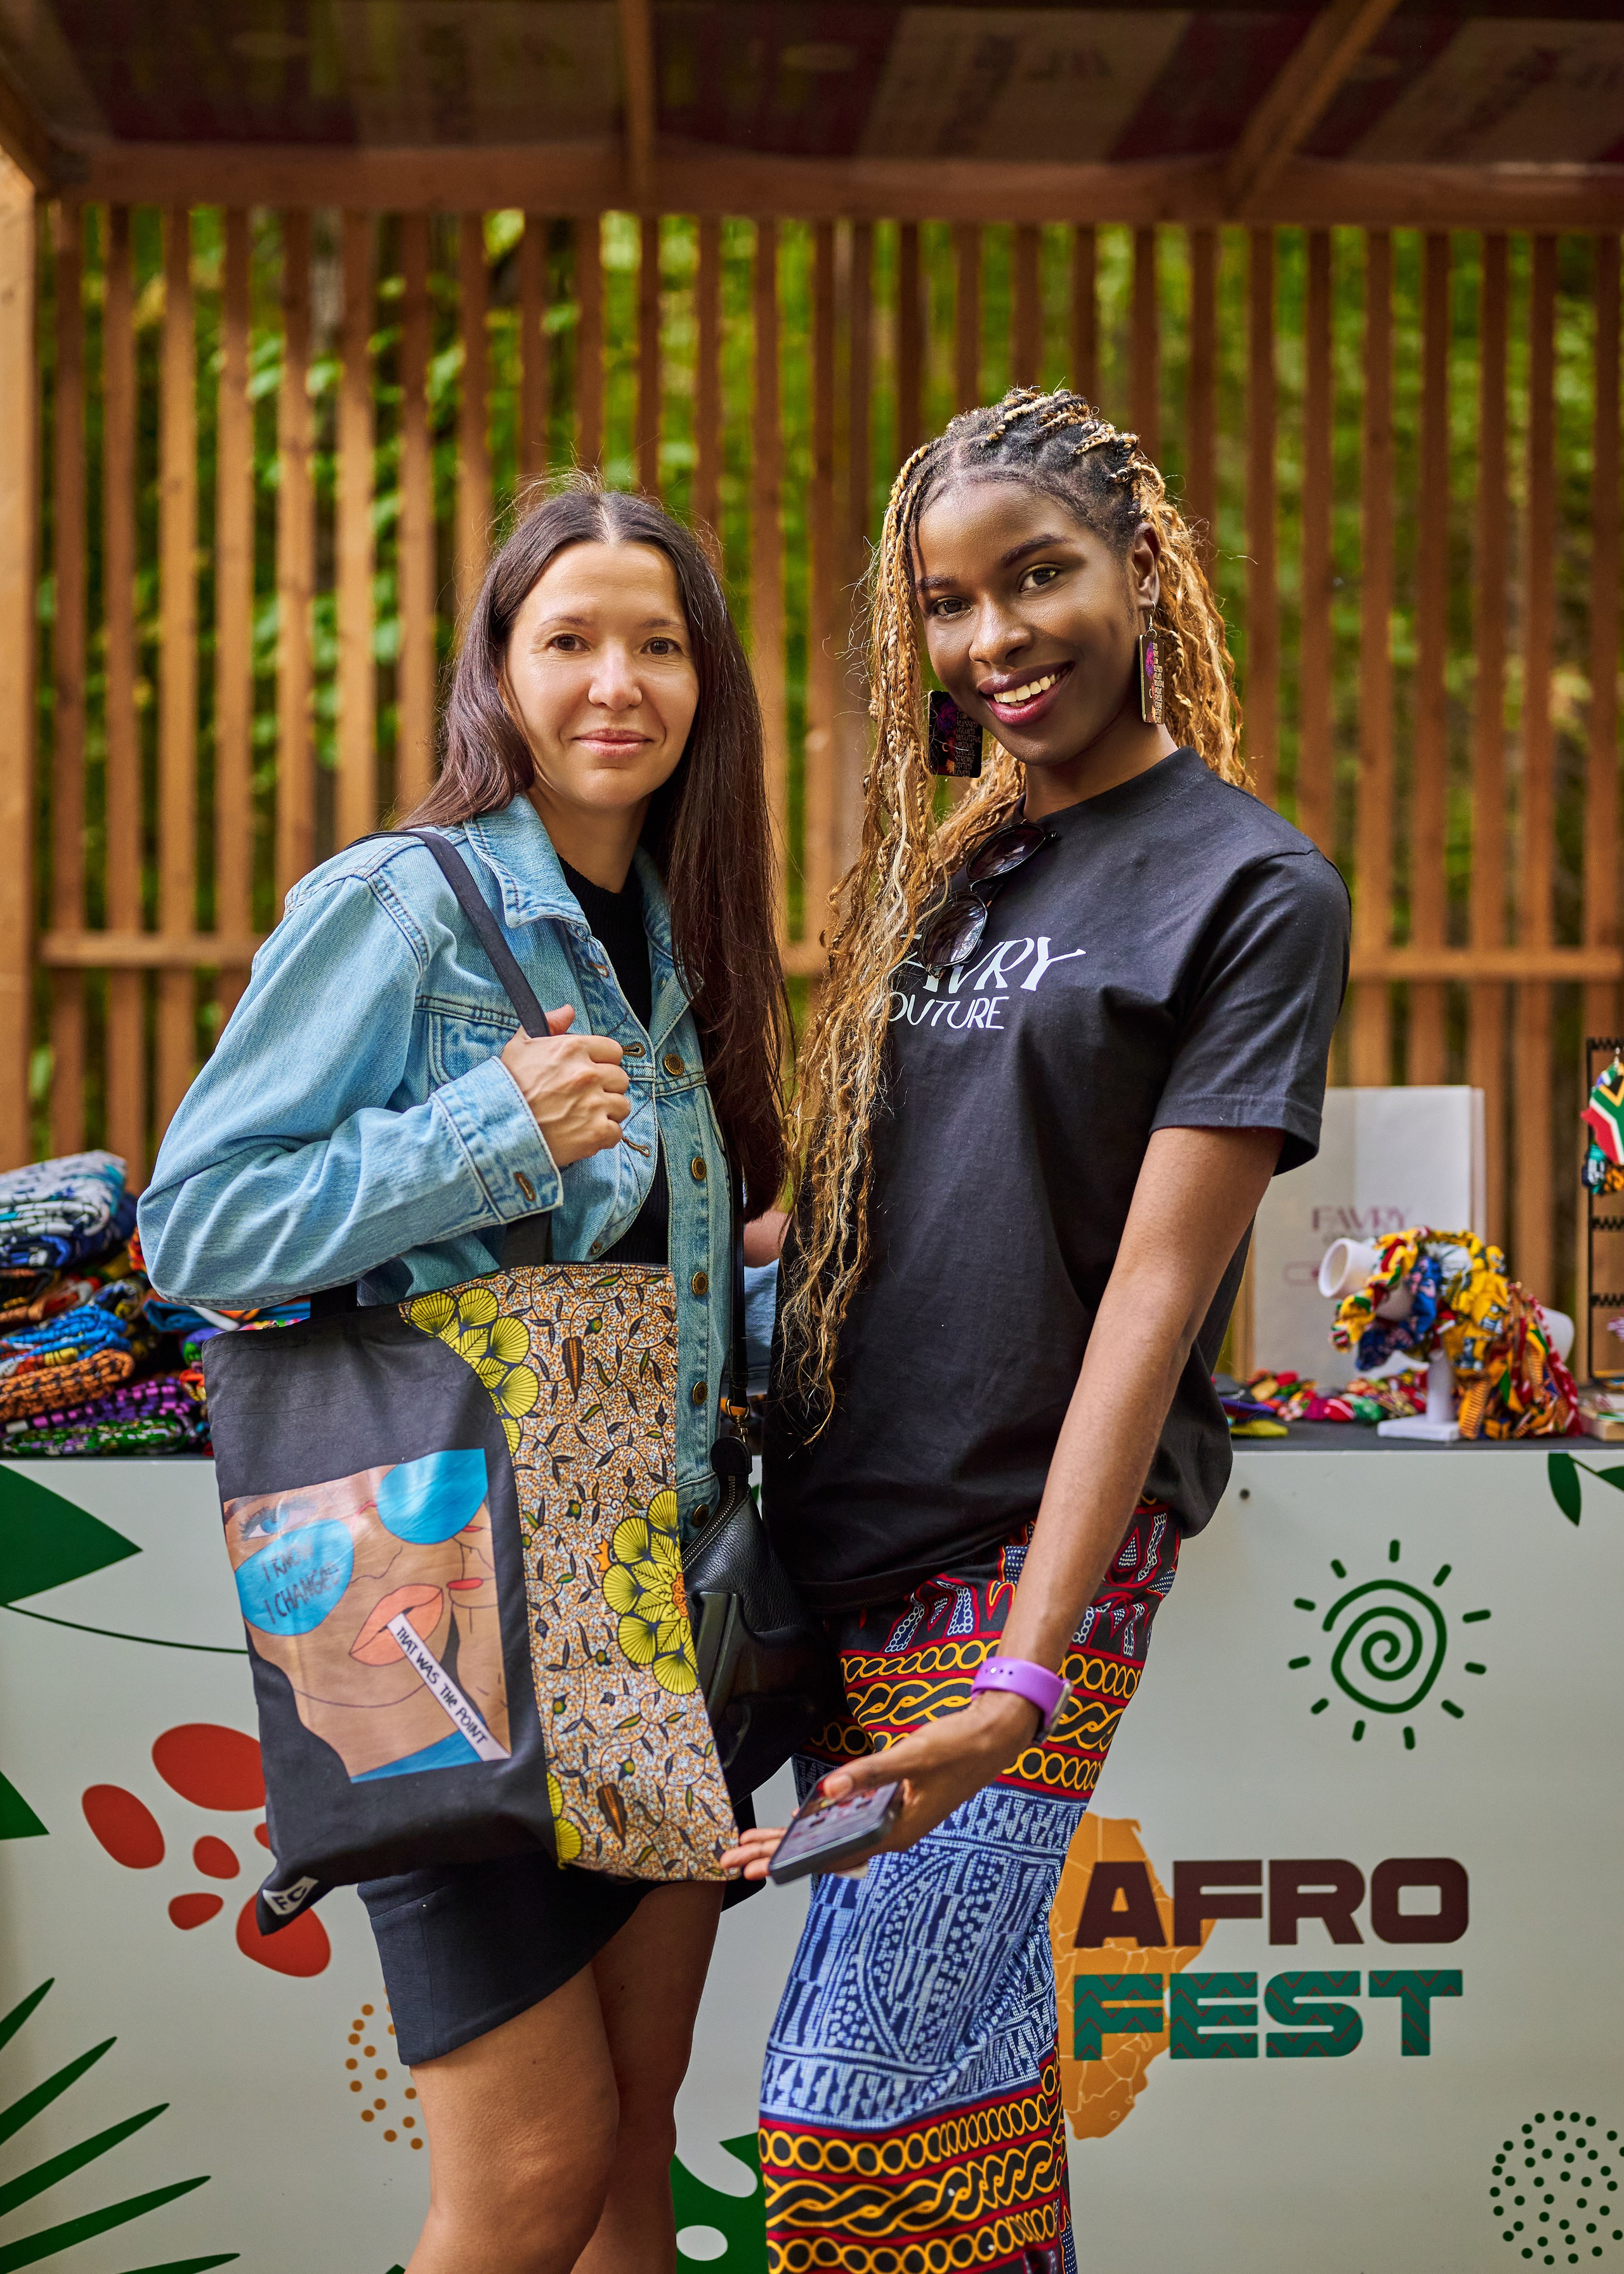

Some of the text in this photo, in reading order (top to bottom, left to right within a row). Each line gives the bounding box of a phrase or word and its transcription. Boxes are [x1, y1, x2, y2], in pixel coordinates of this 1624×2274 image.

[889, 991, 1009, 1029] OUTURE
[396, 1626, 417, 1655] THAT
[416, 1652, 440, 1684] WAS
[455, 1707, 488, 1744] POINT
[1073, 1857, 1469, 1949] AFRO
[1073, 1969, 1464, 2061] FEST
